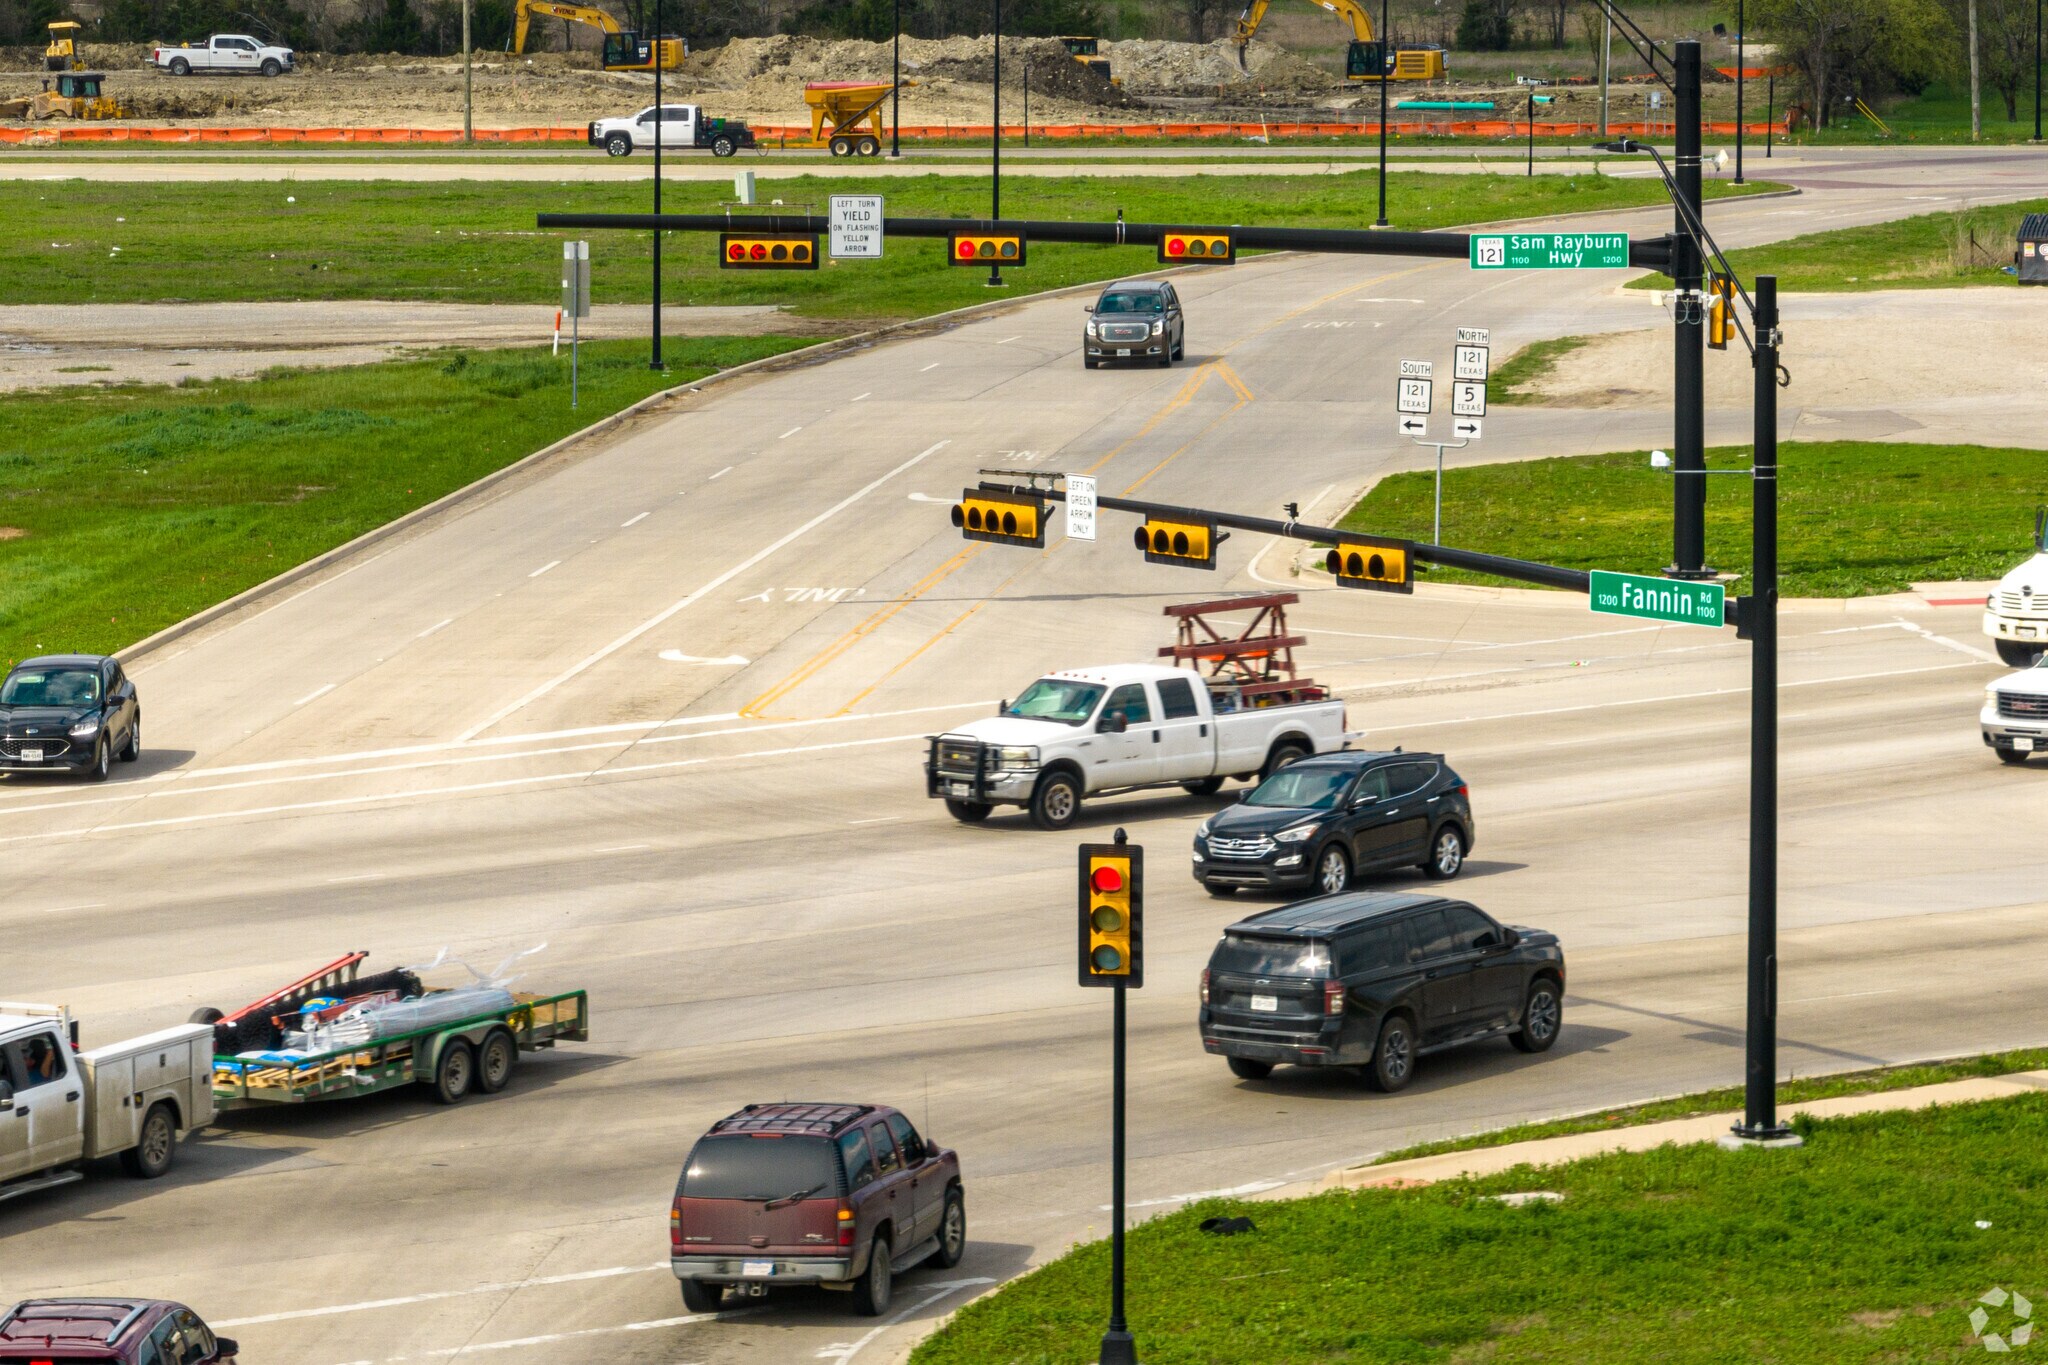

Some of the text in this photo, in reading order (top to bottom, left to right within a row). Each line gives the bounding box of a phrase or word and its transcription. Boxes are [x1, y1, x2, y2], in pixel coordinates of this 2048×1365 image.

[837, 200, 876, 208] LEFT TURN
[842, 210, 871, 221] YIELD
[833, 224, 880, 232] ON FLASHING
[843, 234, 870, 242] YELLOW
[1481, 238, 1500, 246] TEXAS
[1511, 233, 1623, 253] Sam Rayburn
[844, 245, 868, 253] ARROW
[1479, 248, 1503, 263] 121
[1511, 251, 1623, 268] 1100 Hwy 1200
[1458, 329, 1489, 343] NORTH
[1463, 351, 1482, 364] 121
[1402, 362, 1432, 375] SOUTH
[1459, 366, 1484, 376] TEXAS
[1406, 384, 1424, 396] 121
[1464, 387, 1475, 402] 5
[1402, 399, 1427, 408] TEXAS
[1457, 403, 1482, 412] TEXAS
[1069, 480, 1095, 492] LEFT ON
[1071, 494, 1092, 506] GREEN
[1070, 509, 1093, 520] ARROW
[1072, 523, 1089, 534] ONLY
[1598, 582, 1712, 616] 1200 Fannin Rd
[1696, 606, 1716, 619] 1100
